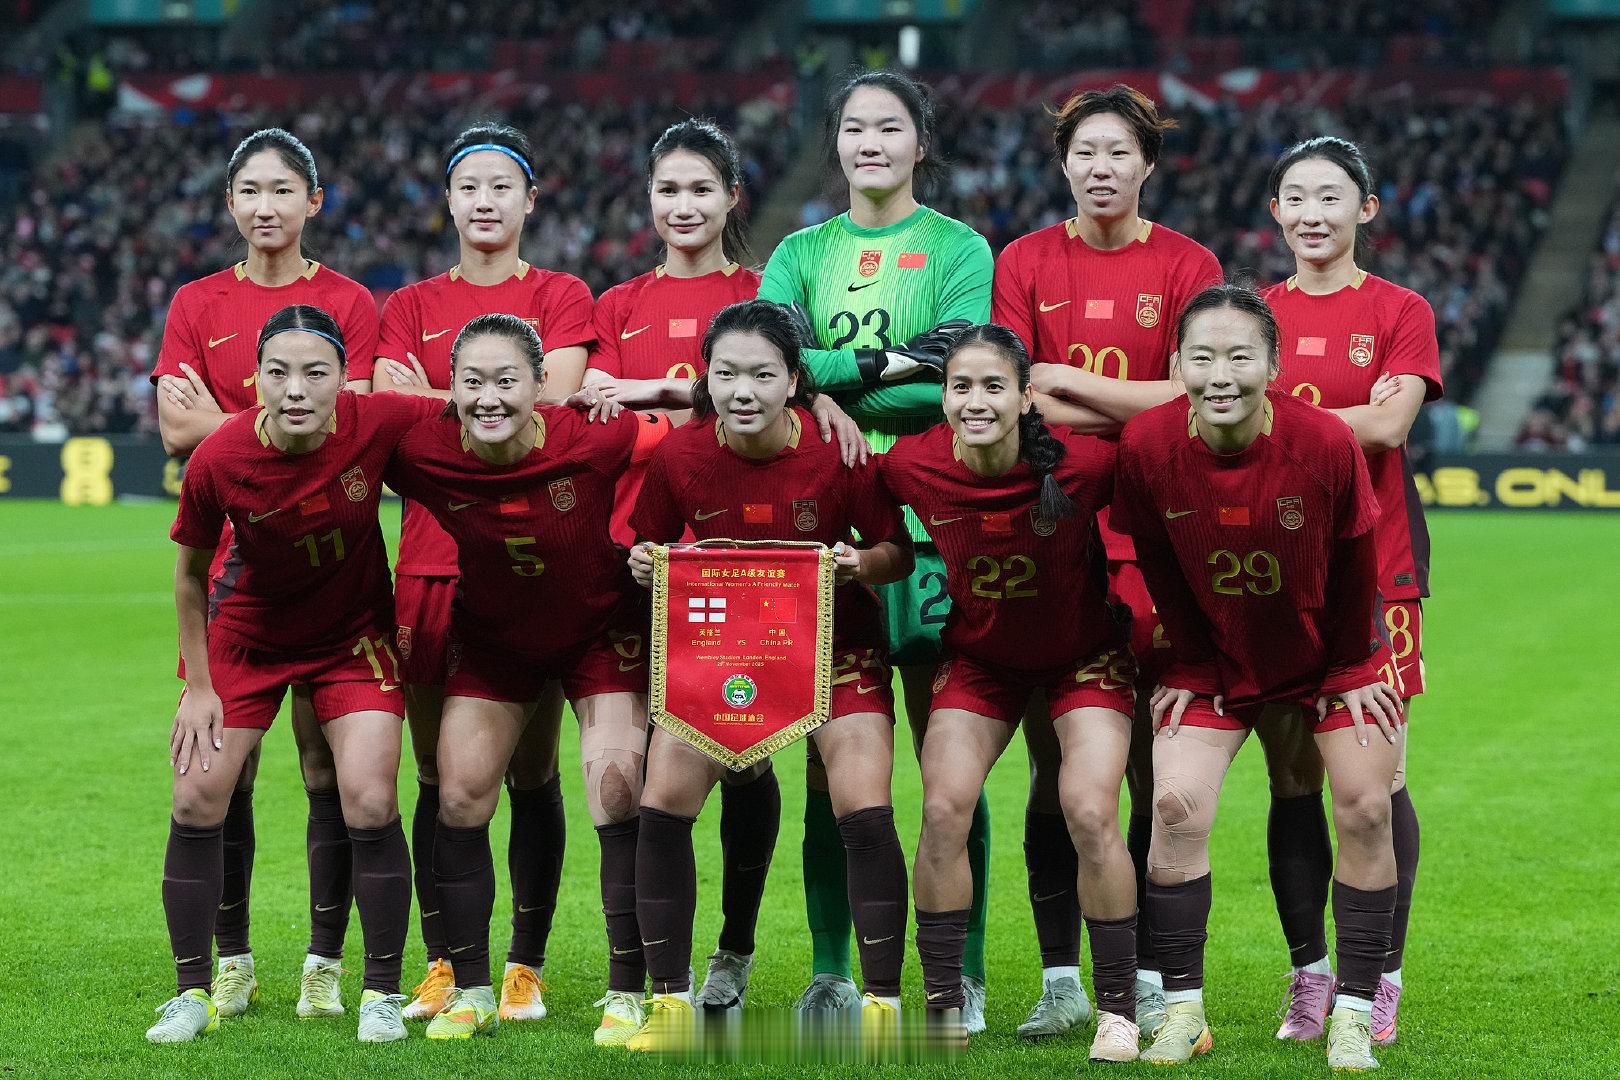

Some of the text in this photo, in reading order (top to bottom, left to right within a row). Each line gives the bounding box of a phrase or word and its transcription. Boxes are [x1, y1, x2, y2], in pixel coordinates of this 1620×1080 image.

[293, 527, 345, 567] 11
[505, 537, 545, 577] 5
[966, 555, 1038, 599] 22
[1207, 549, 1281, 596] 29
[691, 639, 721, 648] England
